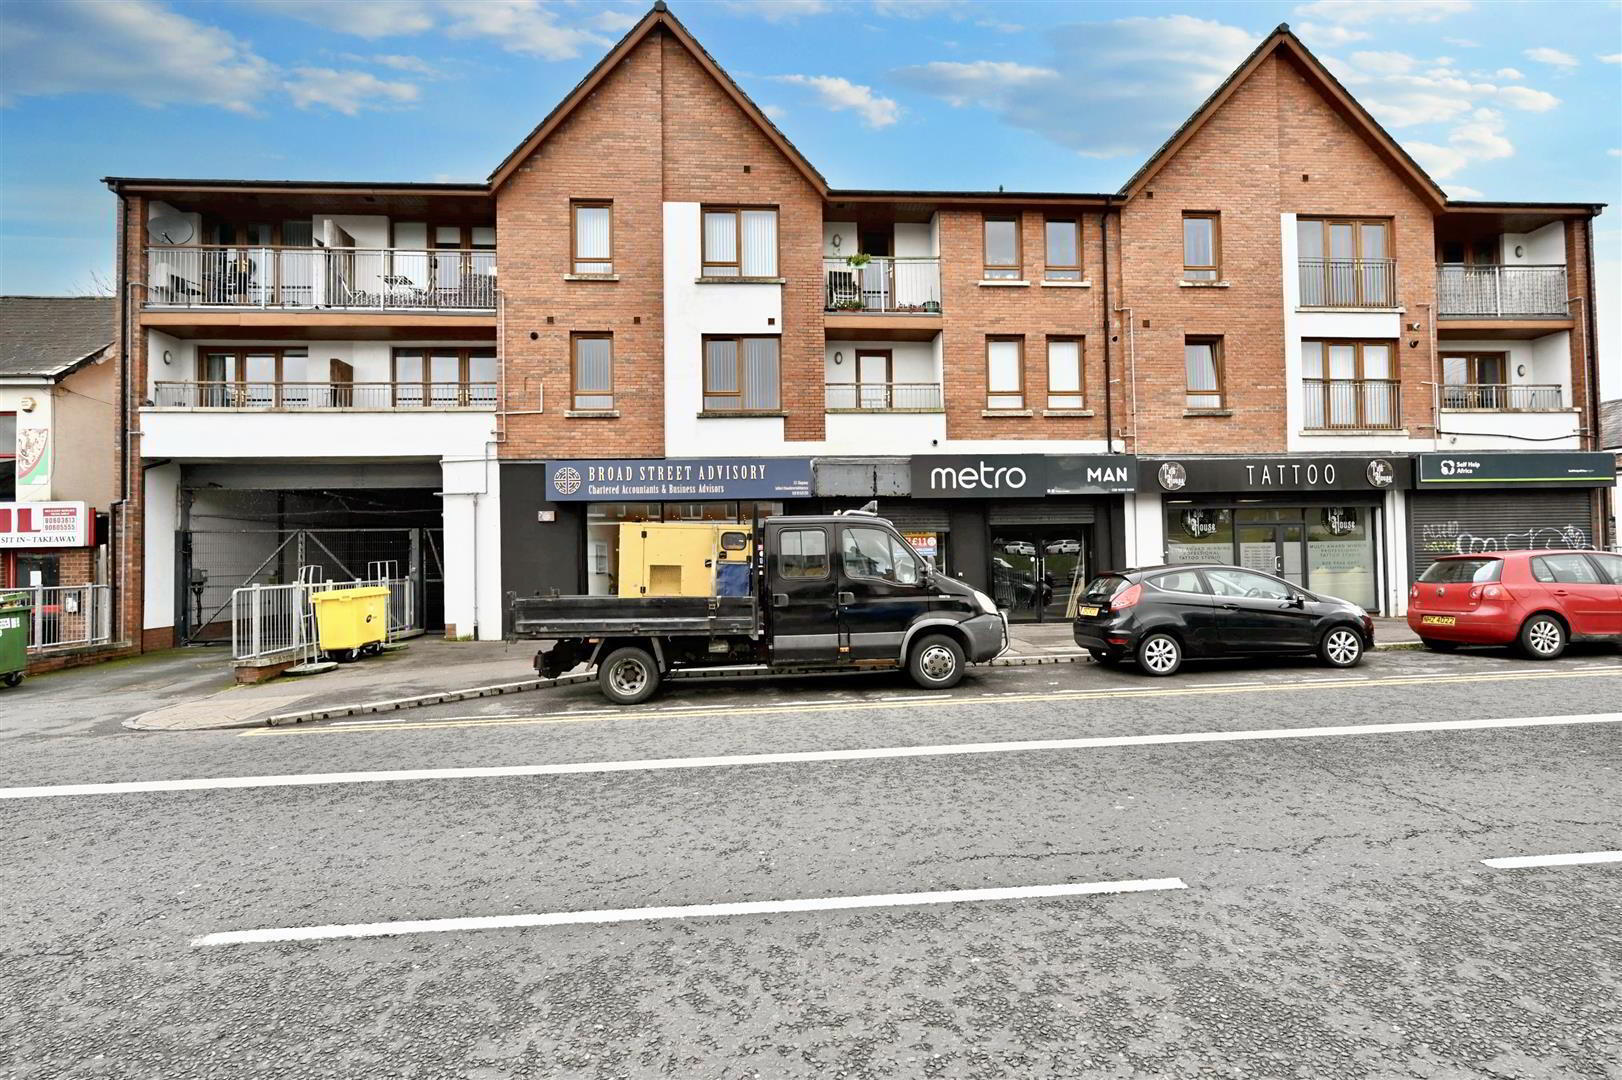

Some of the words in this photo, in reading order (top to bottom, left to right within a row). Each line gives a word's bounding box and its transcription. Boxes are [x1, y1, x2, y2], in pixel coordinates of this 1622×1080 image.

[589, 466, 633, 481] BROAD
[640, 465, 691, 481] STREET
[699, 464, 765, 480] ADVISORY
[931, 461, 1026, 489] metro
[1087, 467, 1128, 482] MAN
[1246, 464, 1335, 485] TATTOO
[589, 484, 619, 494] Chartered
[622, 484, 659, 494] Accountants
[661, 484, 666, 494] &
[669, 484, 696, 493] Business
[699, 483, 725, 493] Advisors
[33, 535, 77, 543] TAKEAWAY
